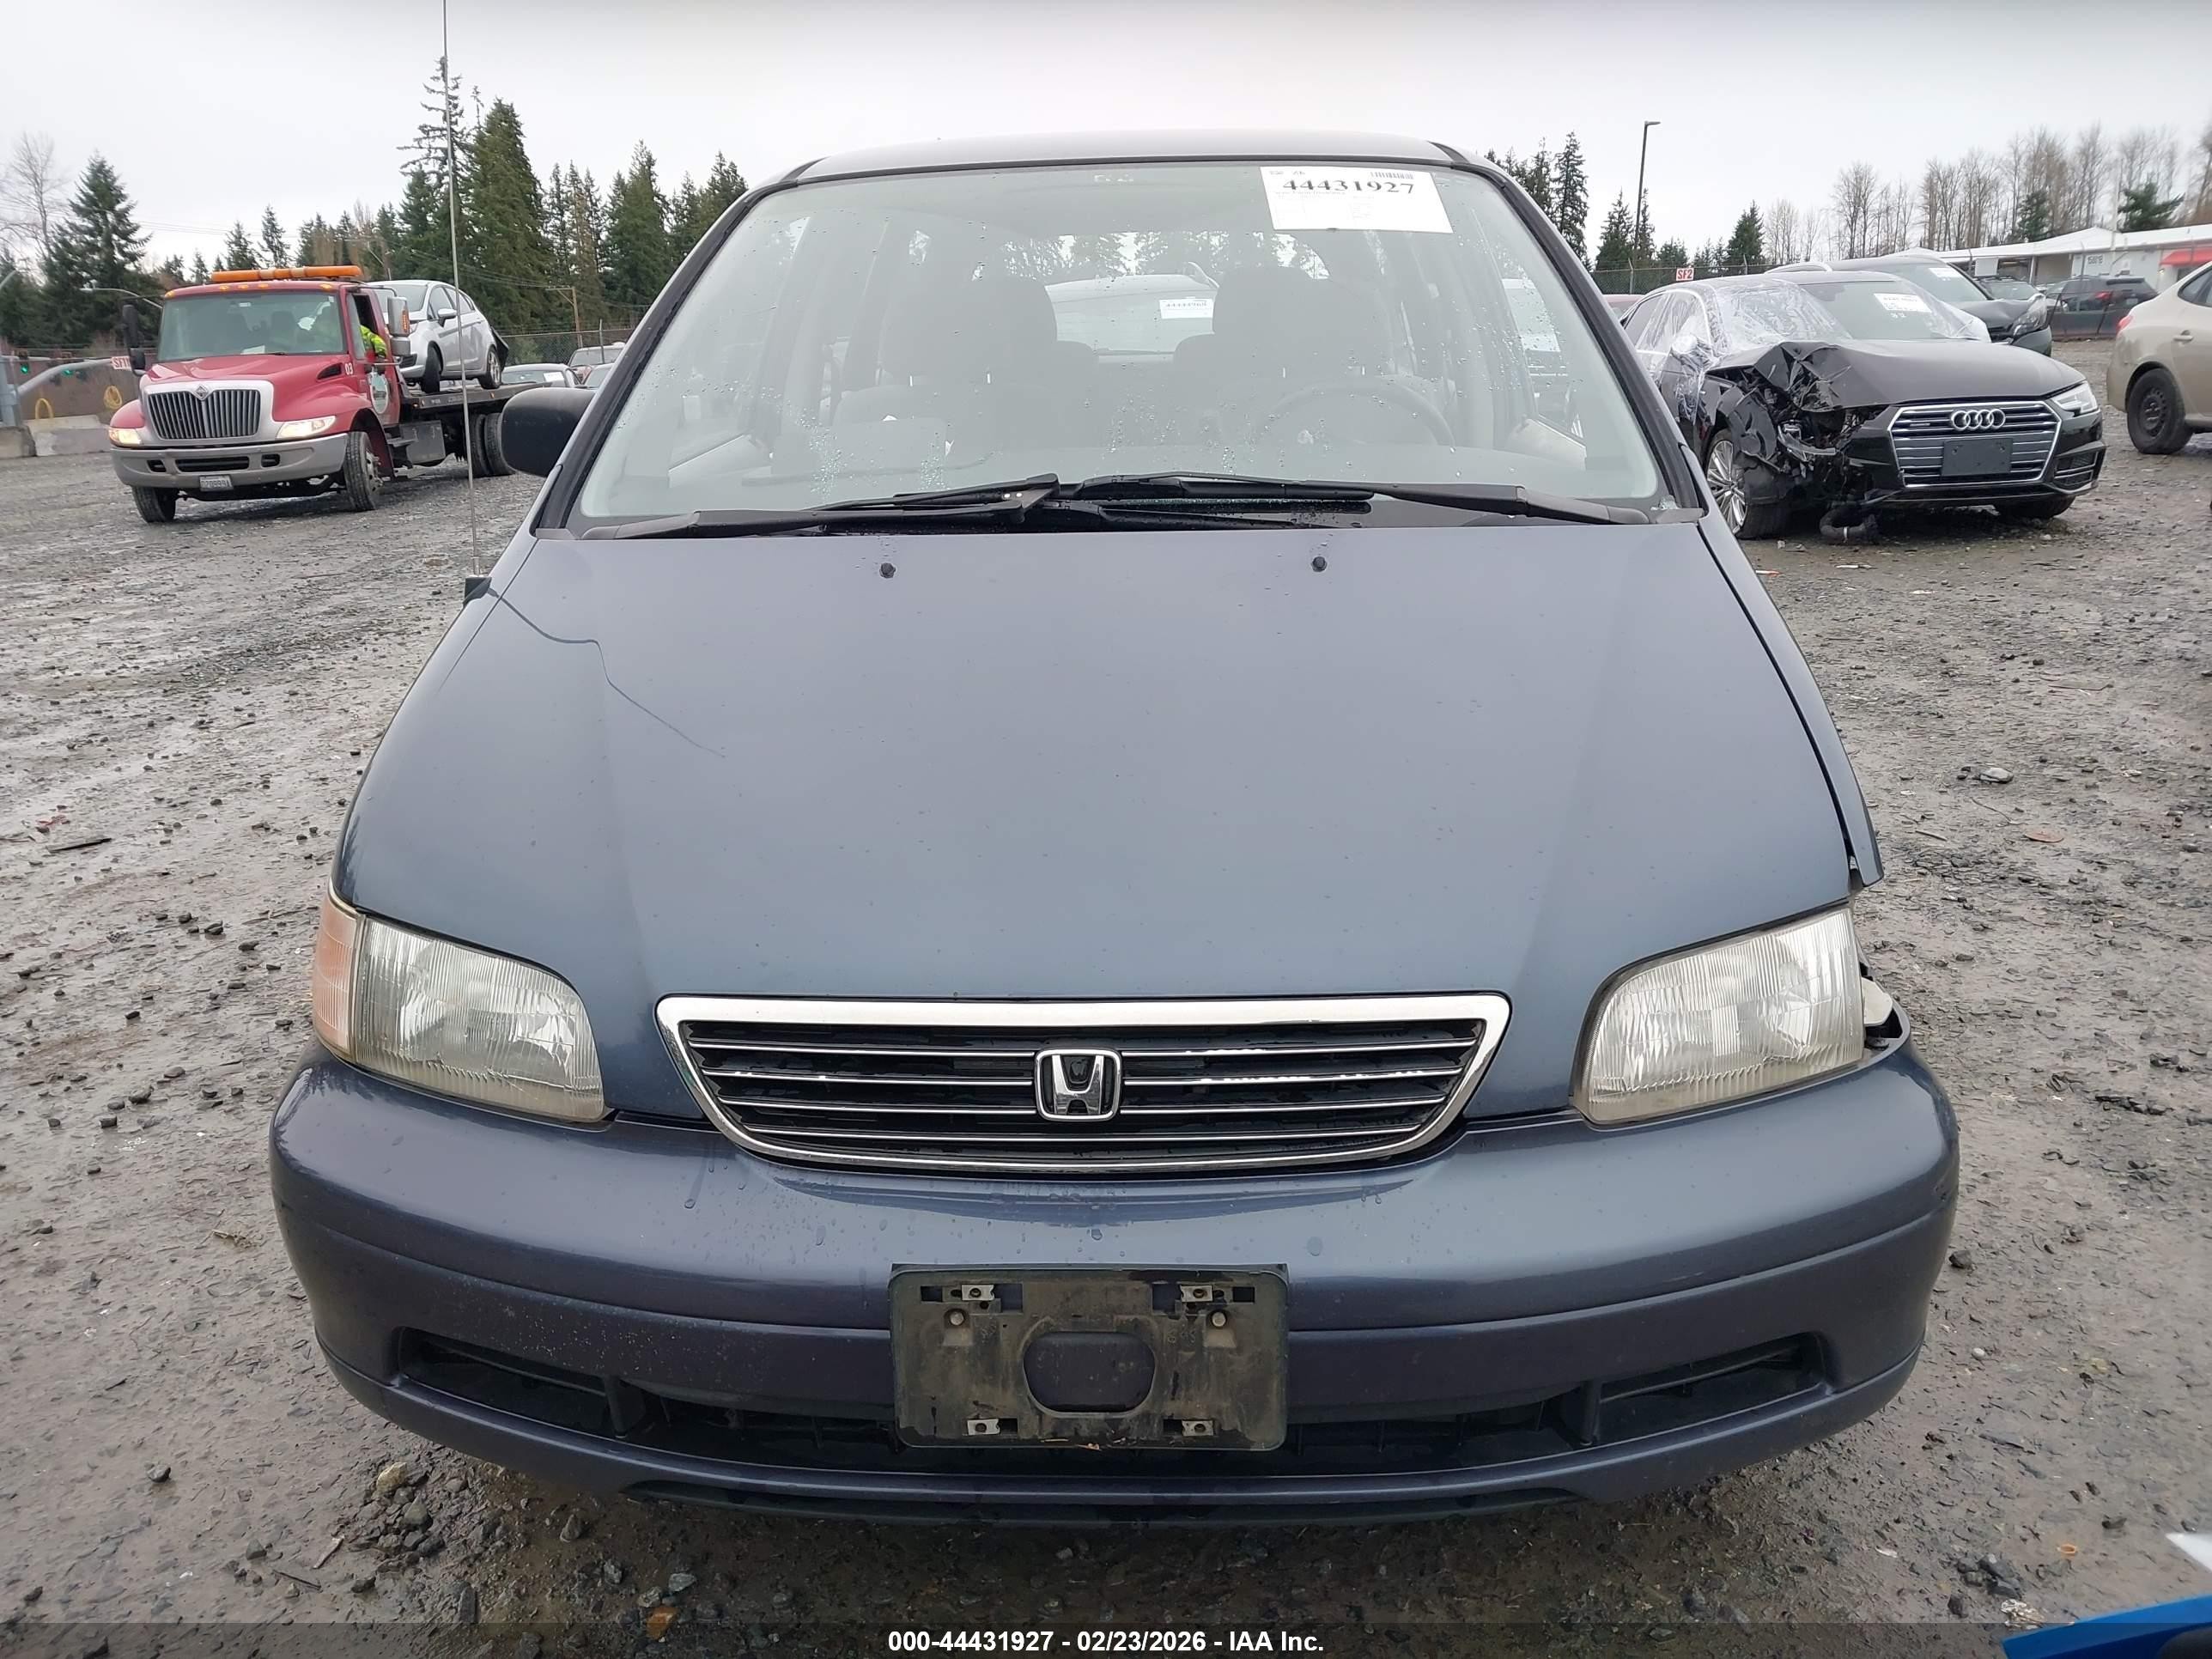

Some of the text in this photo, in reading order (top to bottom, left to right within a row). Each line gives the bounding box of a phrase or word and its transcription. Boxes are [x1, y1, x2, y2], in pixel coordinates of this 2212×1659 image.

[1283, 179, 1414, 194] 44431927
[1677, 269, 1693, 280] SF2
[344, 362, 354, 375] 03
